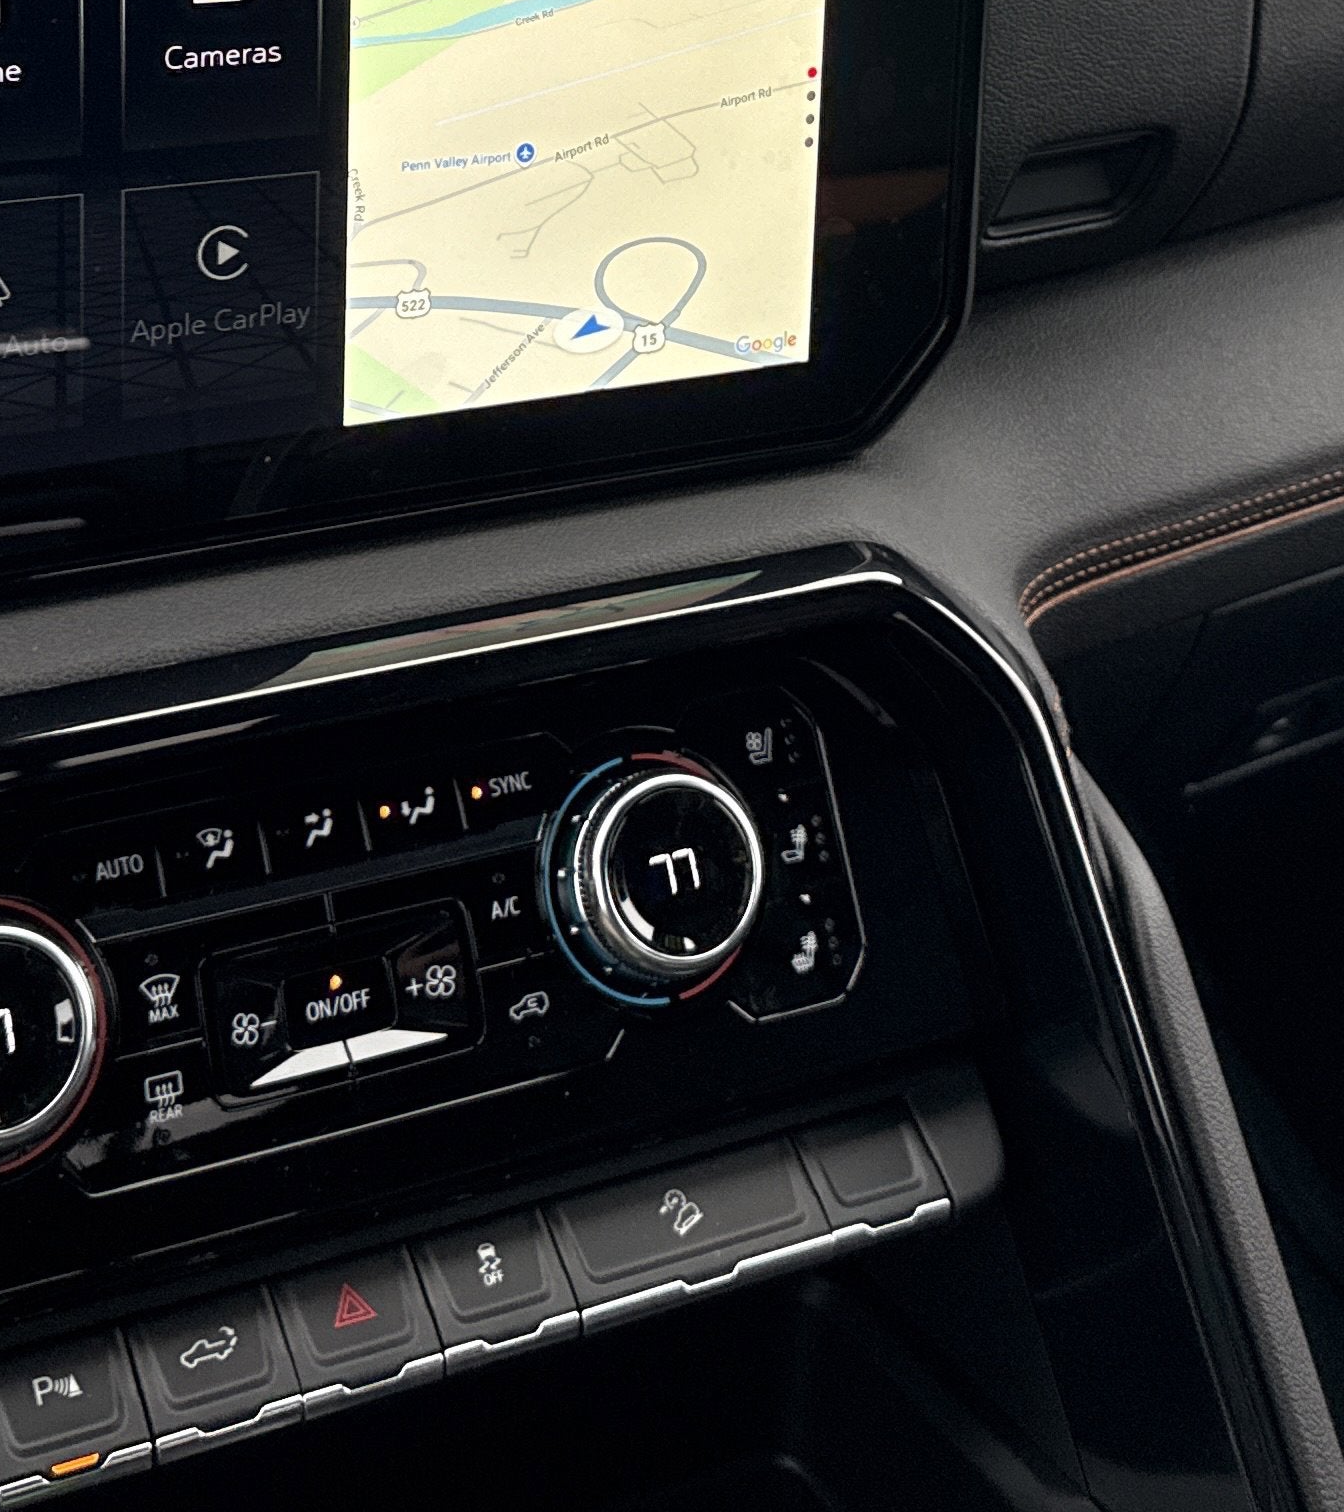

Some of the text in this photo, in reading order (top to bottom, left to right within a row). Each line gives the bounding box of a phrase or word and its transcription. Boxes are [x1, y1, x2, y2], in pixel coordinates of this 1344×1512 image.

[515, 9, 554, 26] Creek Rd
[164, 44, 282, 70] Cameras
[720, 86, 772, 108] Airport Rd
[554, 133, 610, 162] Airport Rd
[401, 152, 512, 172] Penn Valley Airport
[353, 205, 366, 222] Rd
[401, 299, 426, 313] 522
[130, 301, 312, 348] Apple CarPlay
[0, 333, 69, 360] Auto
[641, 333, 657, 347] 15
[734, 331, 798, 355] Google
[483, 323, 545, 389] Jefferson Ave
[488, 770, 533, 797] SYNC
[94, 852, 145, 881] AUTO
[648, 847, 702, 895] 77
[490, 895, 522, 920] A/C
[148, 1003, 180, 1024] MAX
[305, 988, 372, 1024] ON/OFF
[148, 1103, 184, 1124] REAR
